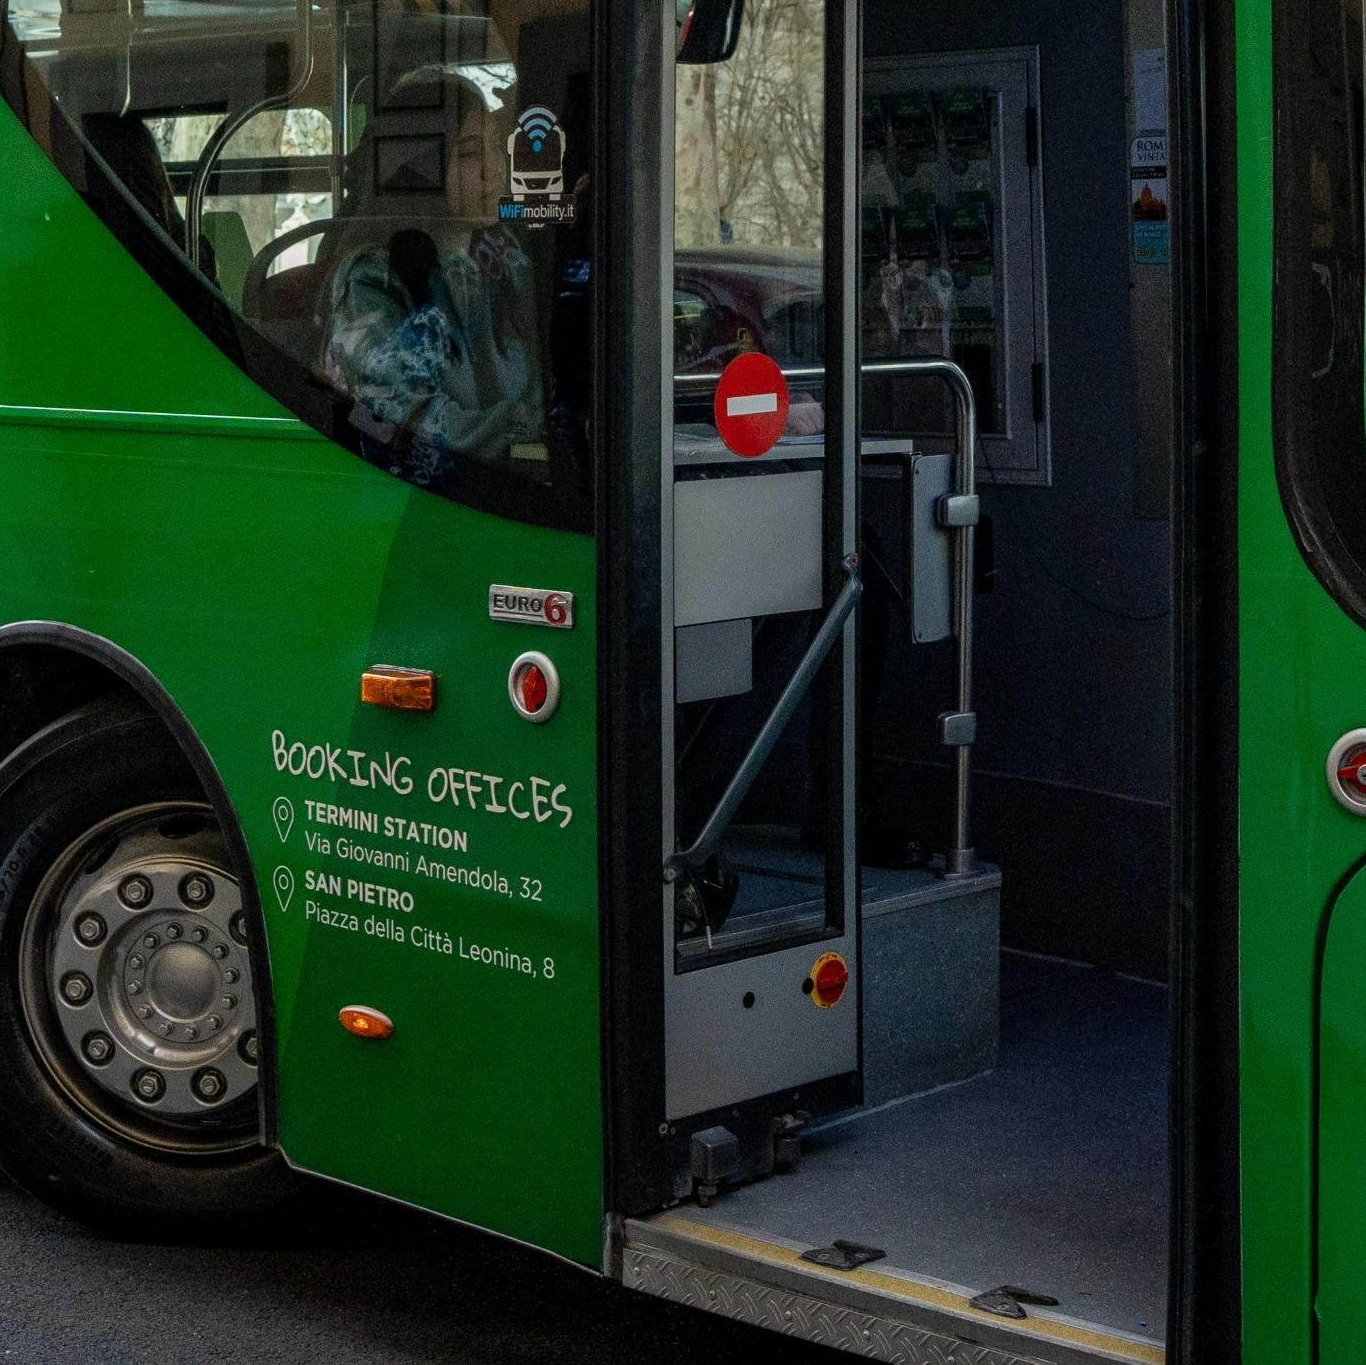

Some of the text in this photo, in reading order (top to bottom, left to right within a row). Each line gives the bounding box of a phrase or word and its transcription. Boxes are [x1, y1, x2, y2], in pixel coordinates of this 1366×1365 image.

[1137, 140, 1165, 151] ROM
[499, 202, 574, 221] WiFimobility.it
[272, 730, 572, 828] BOOKING OFFICES
[305, 800, 468, 852] TERMINI STATION
[305, 830, 543, 902] Via Giovanni Amendola, 32
[305, 870, 414, 913] SAN PIETRO
[305, 900, 555, 979] Piazza della Città Leonina, 8
